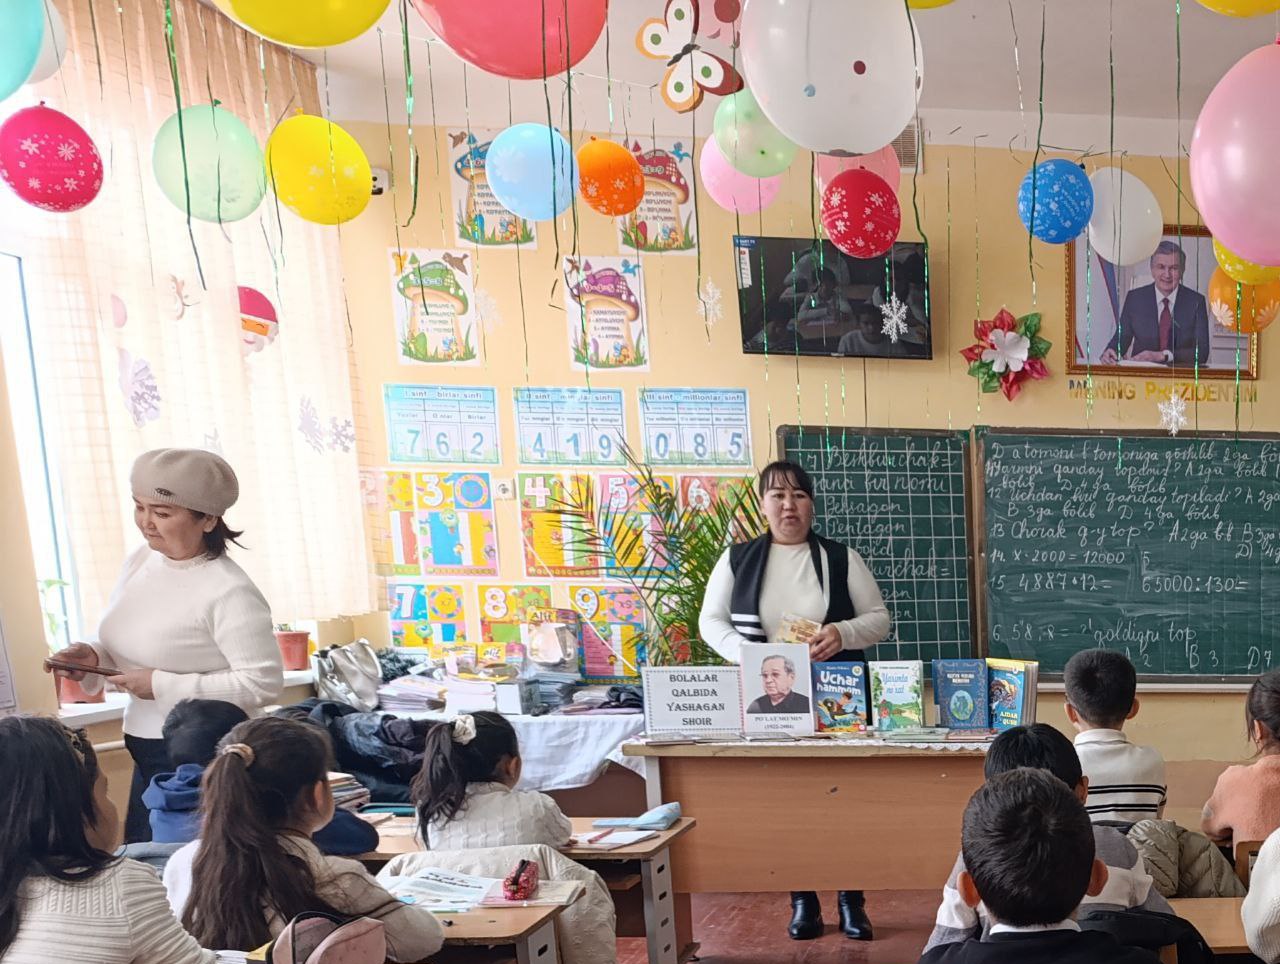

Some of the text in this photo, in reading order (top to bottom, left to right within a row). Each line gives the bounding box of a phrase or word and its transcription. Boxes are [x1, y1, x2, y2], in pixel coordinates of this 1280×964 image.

[408, 429, 484, 457] 7 6 2
[533, 432, 612, 459] 4 1 9
[655, 432, 743, 458] 0 8 5
[422, 474, 444, 507] 3
[524, 476, 552, 508] 4
[608, 477, 628, 509] 5
[688, 478, 712, 511] 6
[1008, 502, 1019, 517] B
[1011, 519, 1067, 538] Chorak
[395, 586, 415, 619] 7
[483, 587, 508, 619] 8
[574, 587, 600, 621] 9
[669, 674, 718, 683] BOLALAR
[820, 671, 860, 687] Uchar
[671, 688, 718, 697] QALBIDA
[666, 703, 725, 712] YASHAGAN
[682, 717, 713, 726] SHOIR
